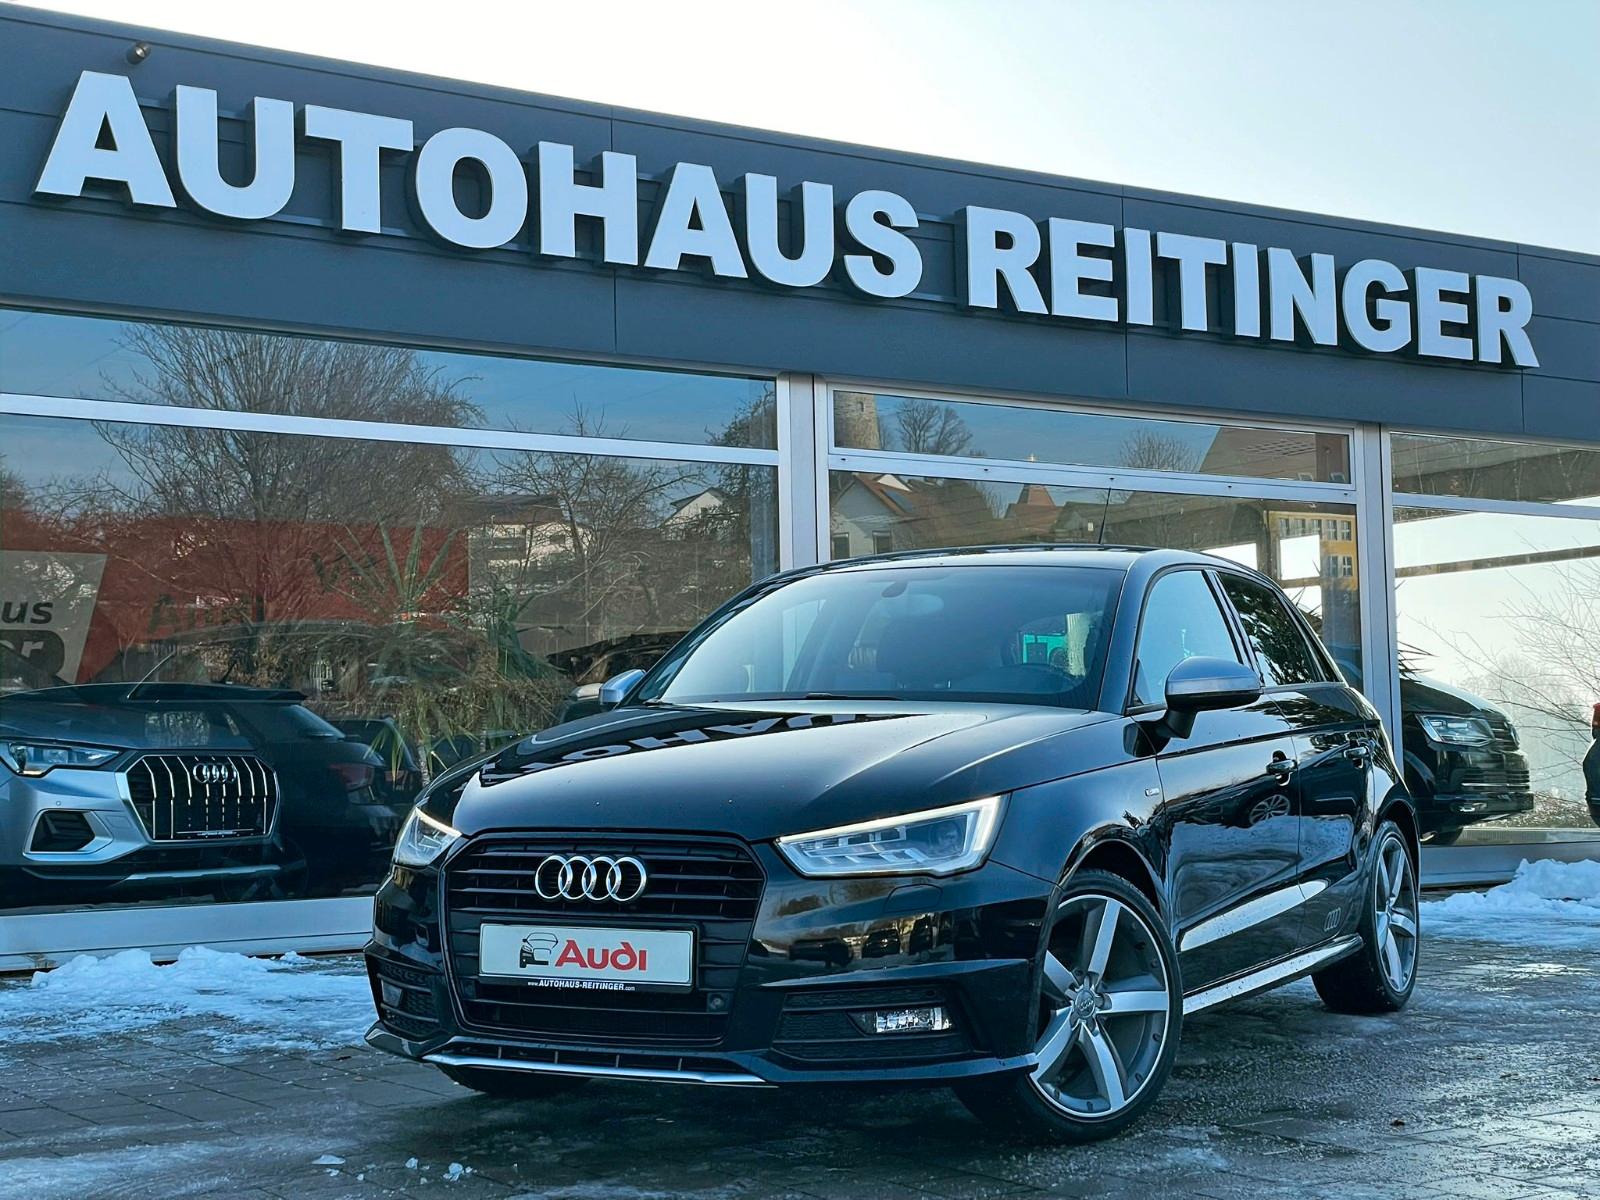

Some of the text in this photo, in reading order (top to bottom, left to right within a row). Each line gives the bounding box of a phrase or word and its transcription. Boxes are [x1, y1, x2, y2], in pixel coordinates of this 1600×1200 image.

[35, 70, 1540, 368] AUTOHAUS REITINGER
[556, 941, 646, 970] Audi
[527, 979, 636, 991] www.AUTOHAUS-REITINGER.com
